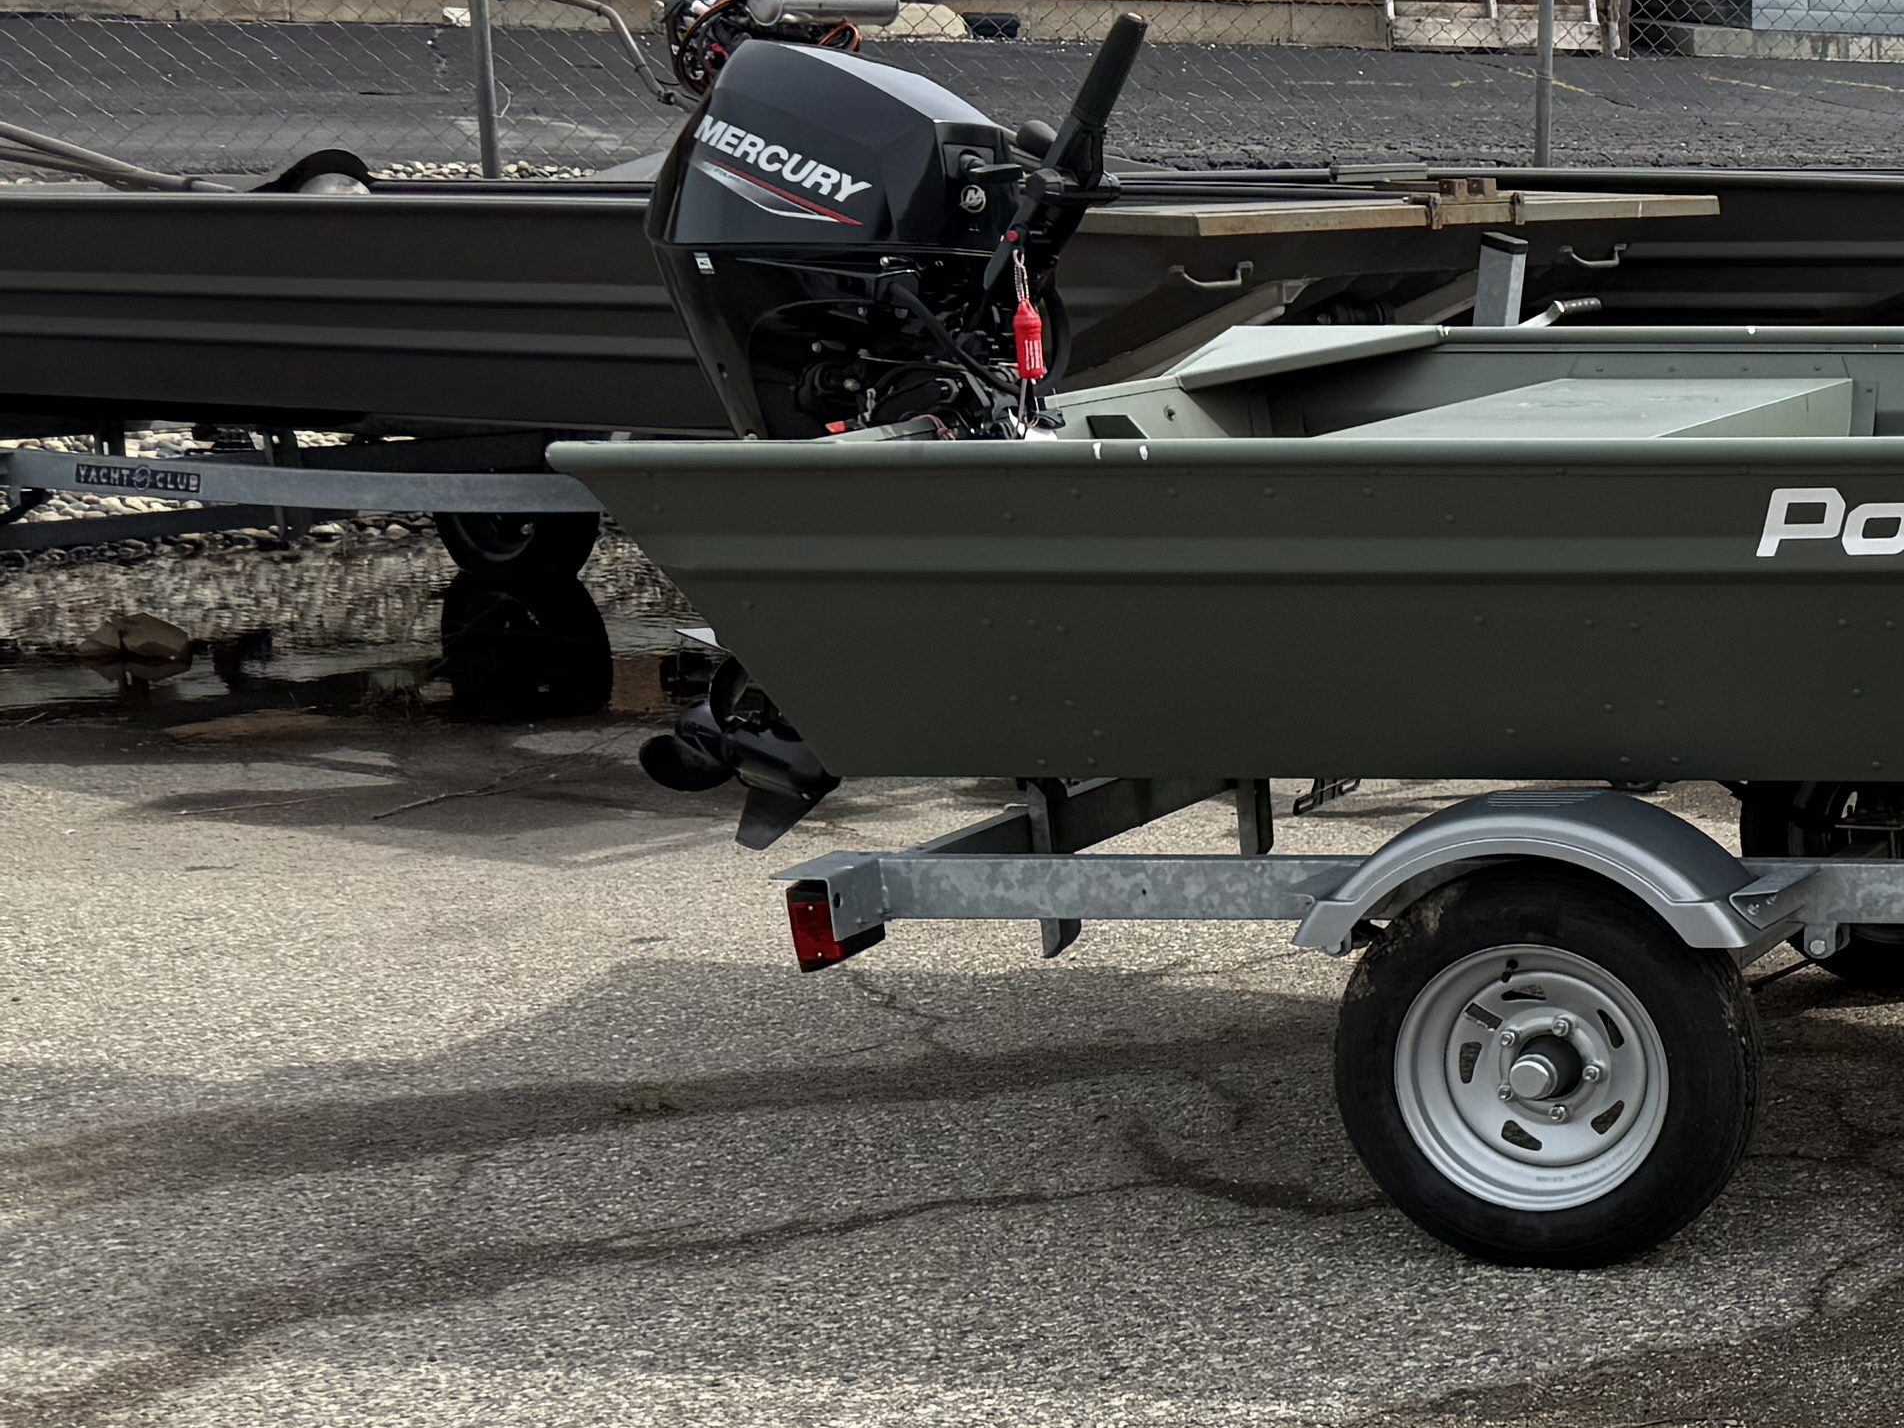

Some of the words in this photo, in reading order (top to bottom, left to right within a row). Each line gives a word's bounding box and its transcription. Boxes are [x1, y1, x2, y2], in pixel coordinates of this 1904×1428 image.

[694, 114, 872, 203] MERCURY
[79, 465, 130, 487] YACHT
[156, 473, 199, 491] CLUB
